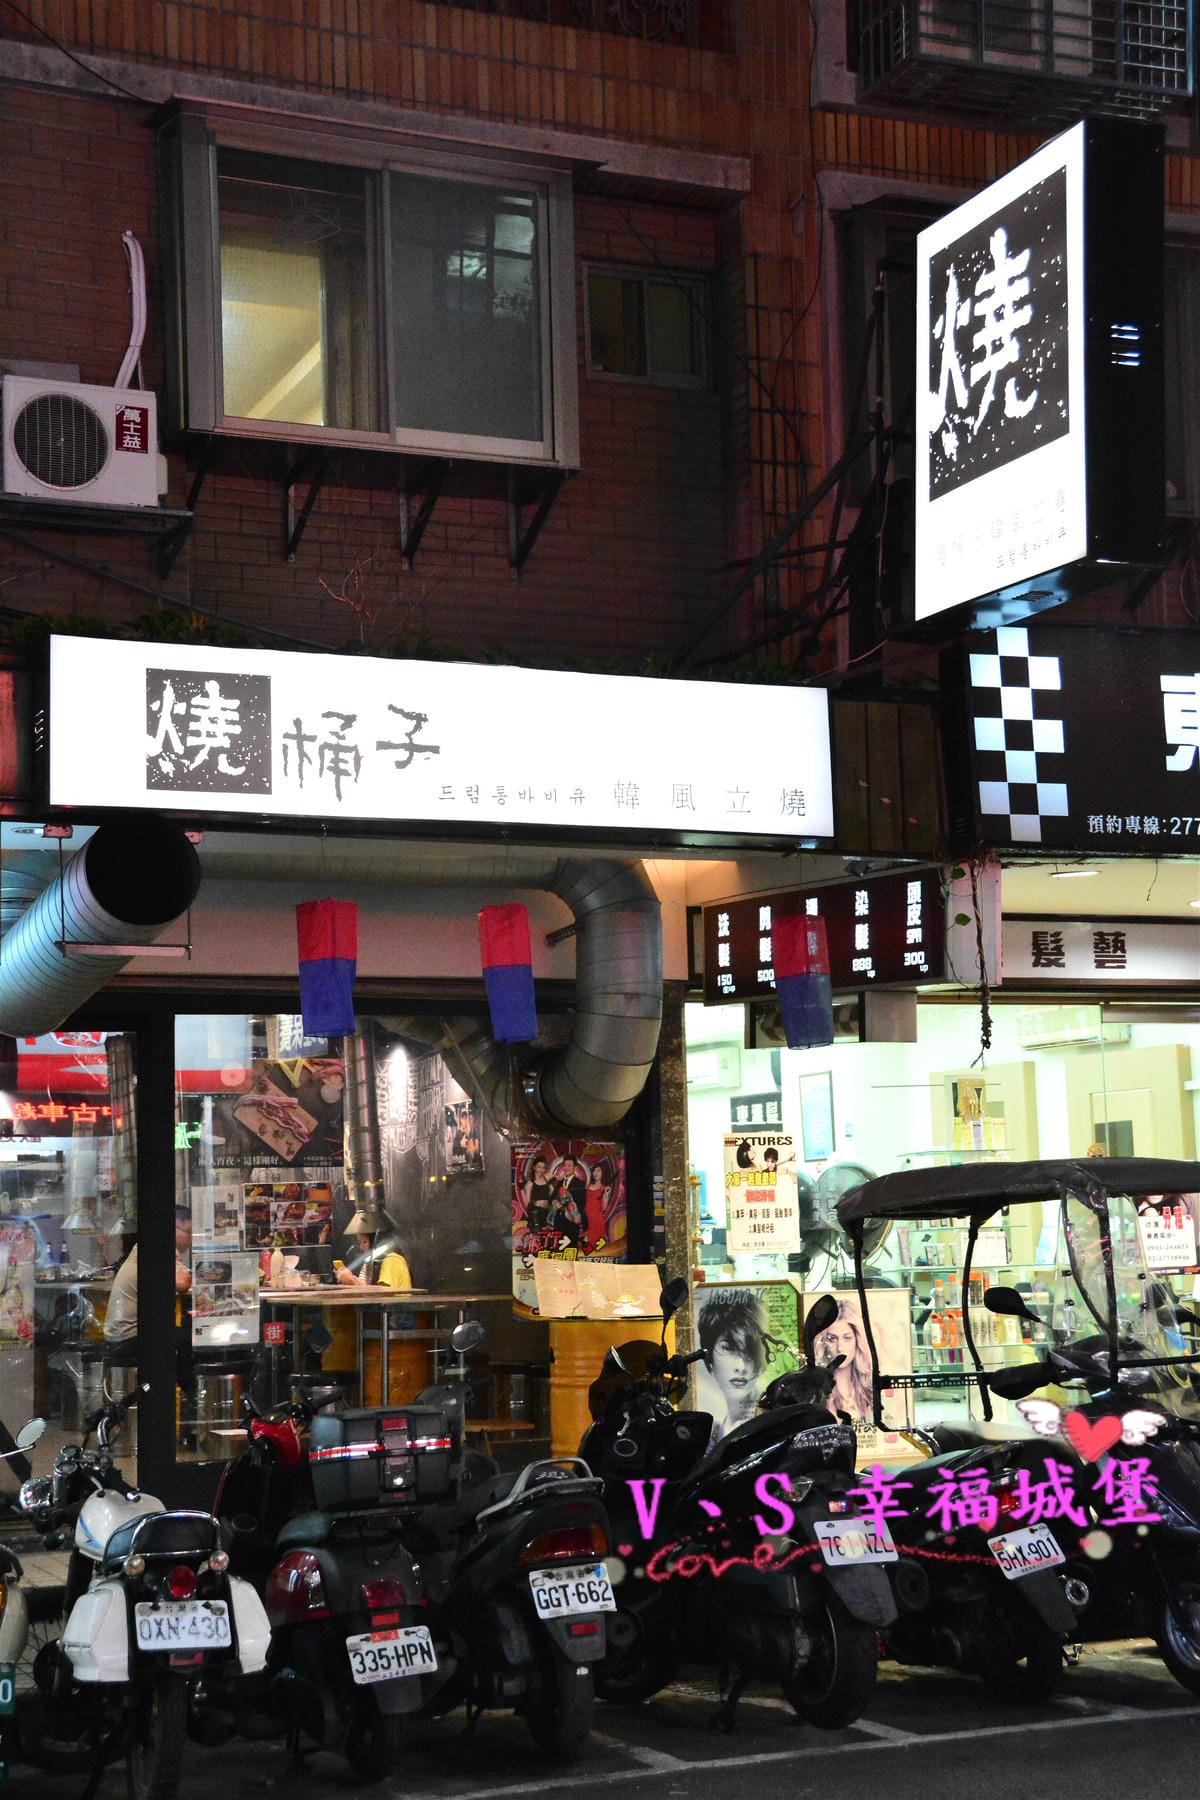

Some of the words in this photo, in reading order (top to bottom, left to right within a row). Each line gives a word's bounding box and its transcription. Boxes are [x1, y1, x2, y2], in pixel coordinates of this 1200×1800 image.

[122, 408, 142, 449] 萬士益
[437, 784, 585, 805] 드럼통바비큐
[613, 780, 806, 817] 韓風立燒
[904, 951, 925, 966] 300
[1031, 931, 1127, 969] 髮藝
[717, 973, 733, 986] 150
